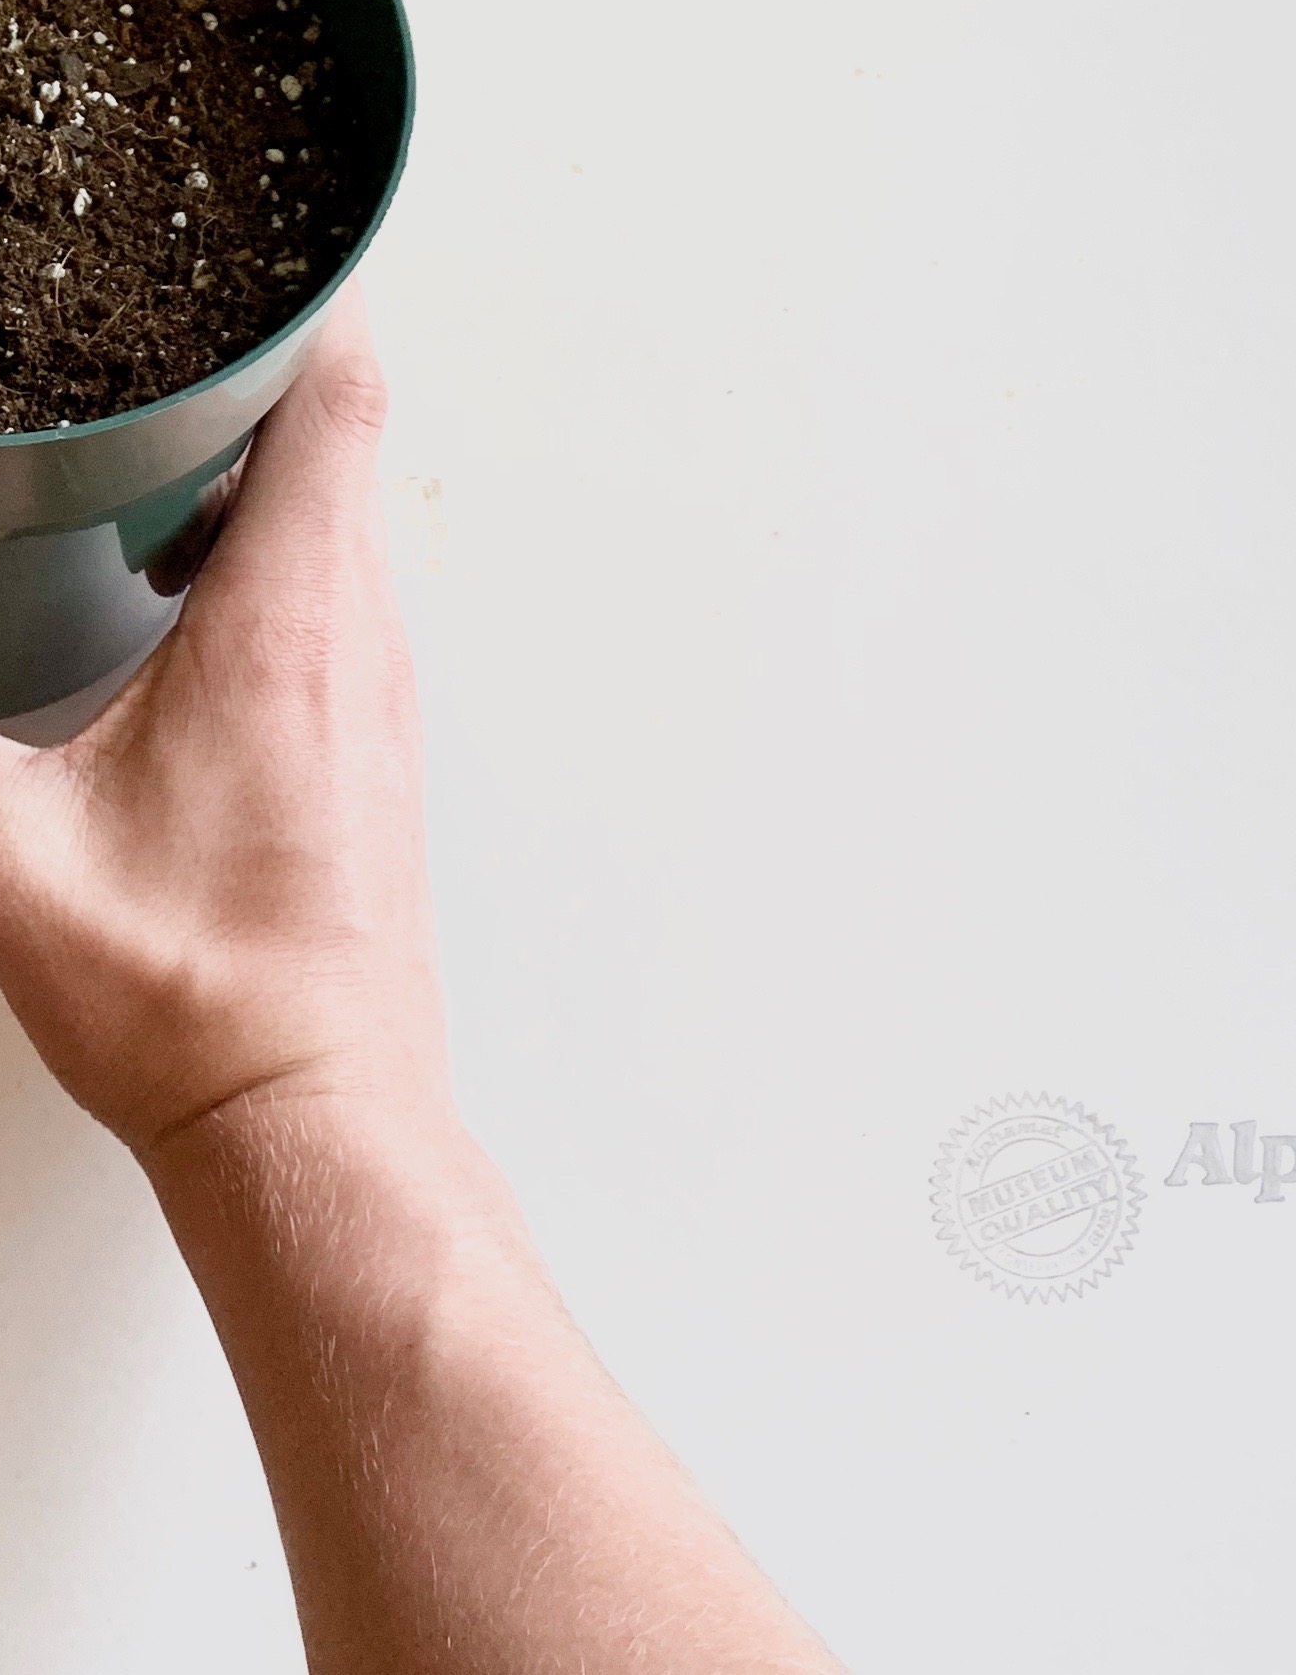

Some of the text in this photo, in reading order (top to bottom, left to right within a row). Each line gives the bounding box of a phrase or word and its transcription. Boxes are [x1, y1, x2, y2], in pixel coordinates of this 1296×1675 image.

[967, 1149, 1100, 1217] MUSEUM
[1163, 1119, 1296, 1203] Alp
[979, 1174, 1109, 1242] QUALITY
